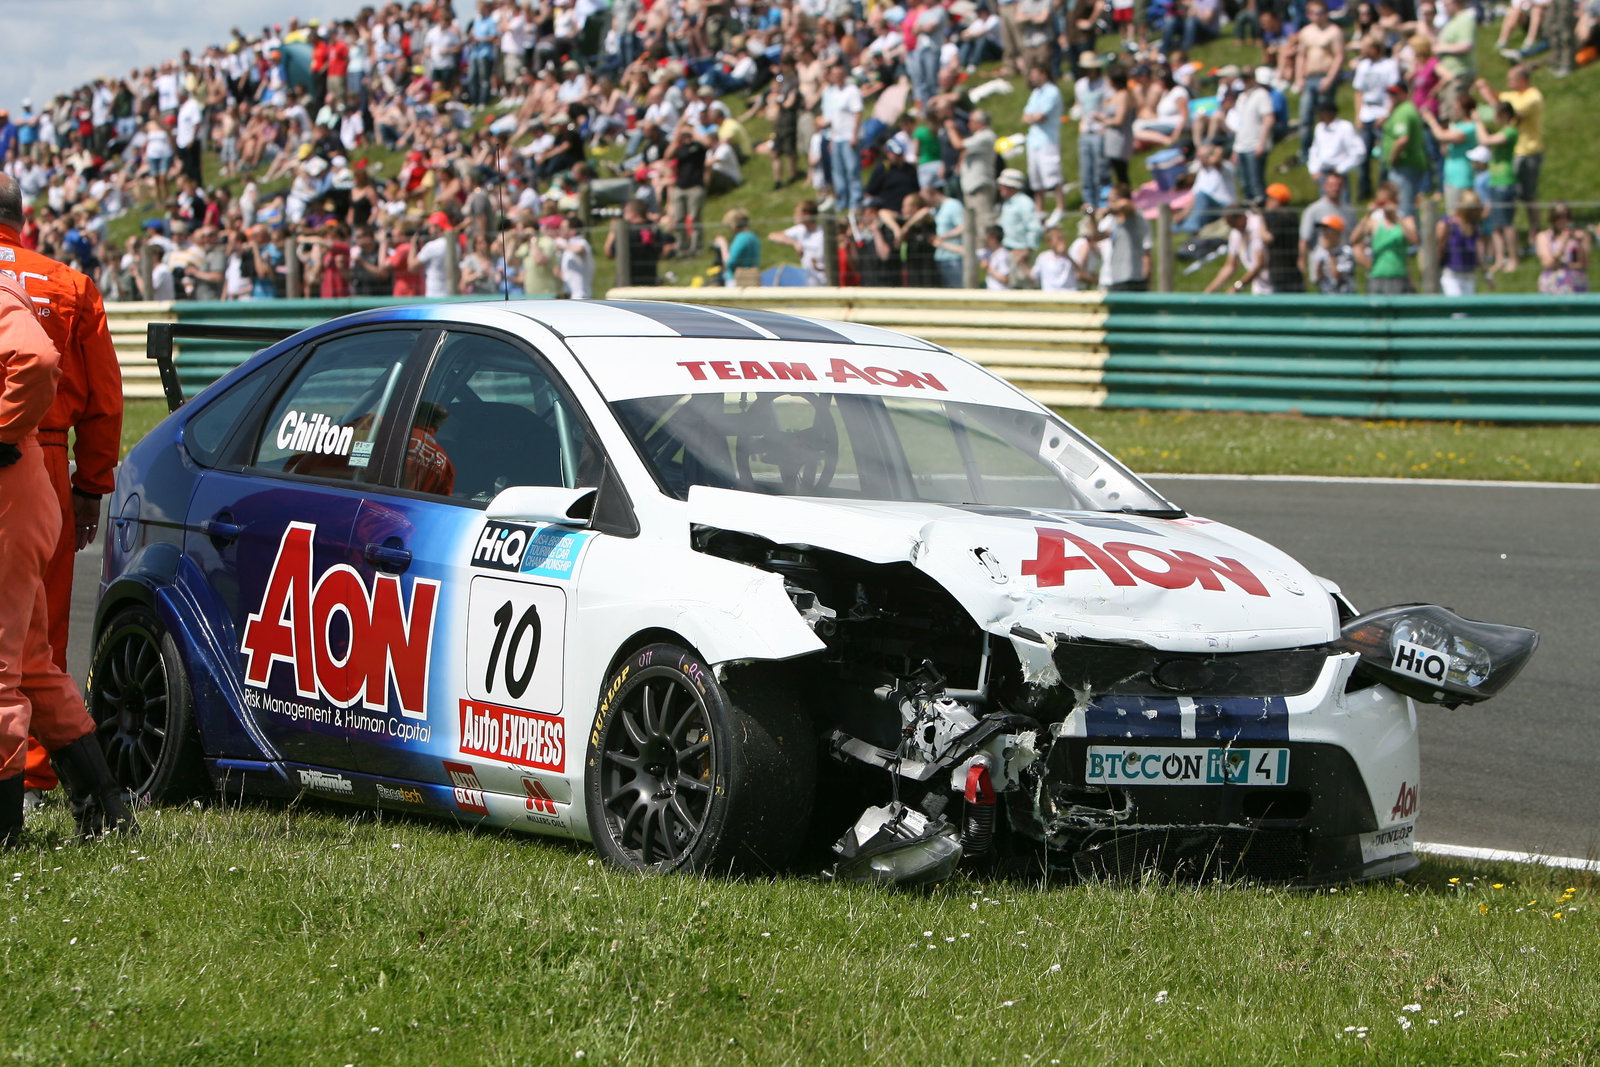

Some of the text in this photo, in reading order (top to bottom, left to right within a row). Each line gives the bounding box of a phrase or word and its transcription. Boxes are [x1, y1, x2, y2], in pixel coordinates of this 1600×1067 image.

[676, 361, 818, 382] TEAM
[276, 410, 354, 456] Chilton
[474, 526, 526, 568] HiQ
[530, 545, 571, 560] TOURING CAR
[525, 555, 572, 572] CHAMPIONSHIP
[486, 600, 542, 700] 10
[1395, 645, 1445, 681] HiQ
[244, 688, 432, 744] Risk Management & Human Capital
[591, 665, 630, 748] DUNLOP
[462, 705, 563, 766] Auto EXPRESS
[1255, 752, 1271, 779] 4
[297, 769, 353, 791] Dynamics
[449, 770, 480, 789] AUTO
[454, 787, 485, 807] GLYM
[526, 815, 567, 829] MILLERS OILS
[1376, 826, 1413, 847] DUNLOP
